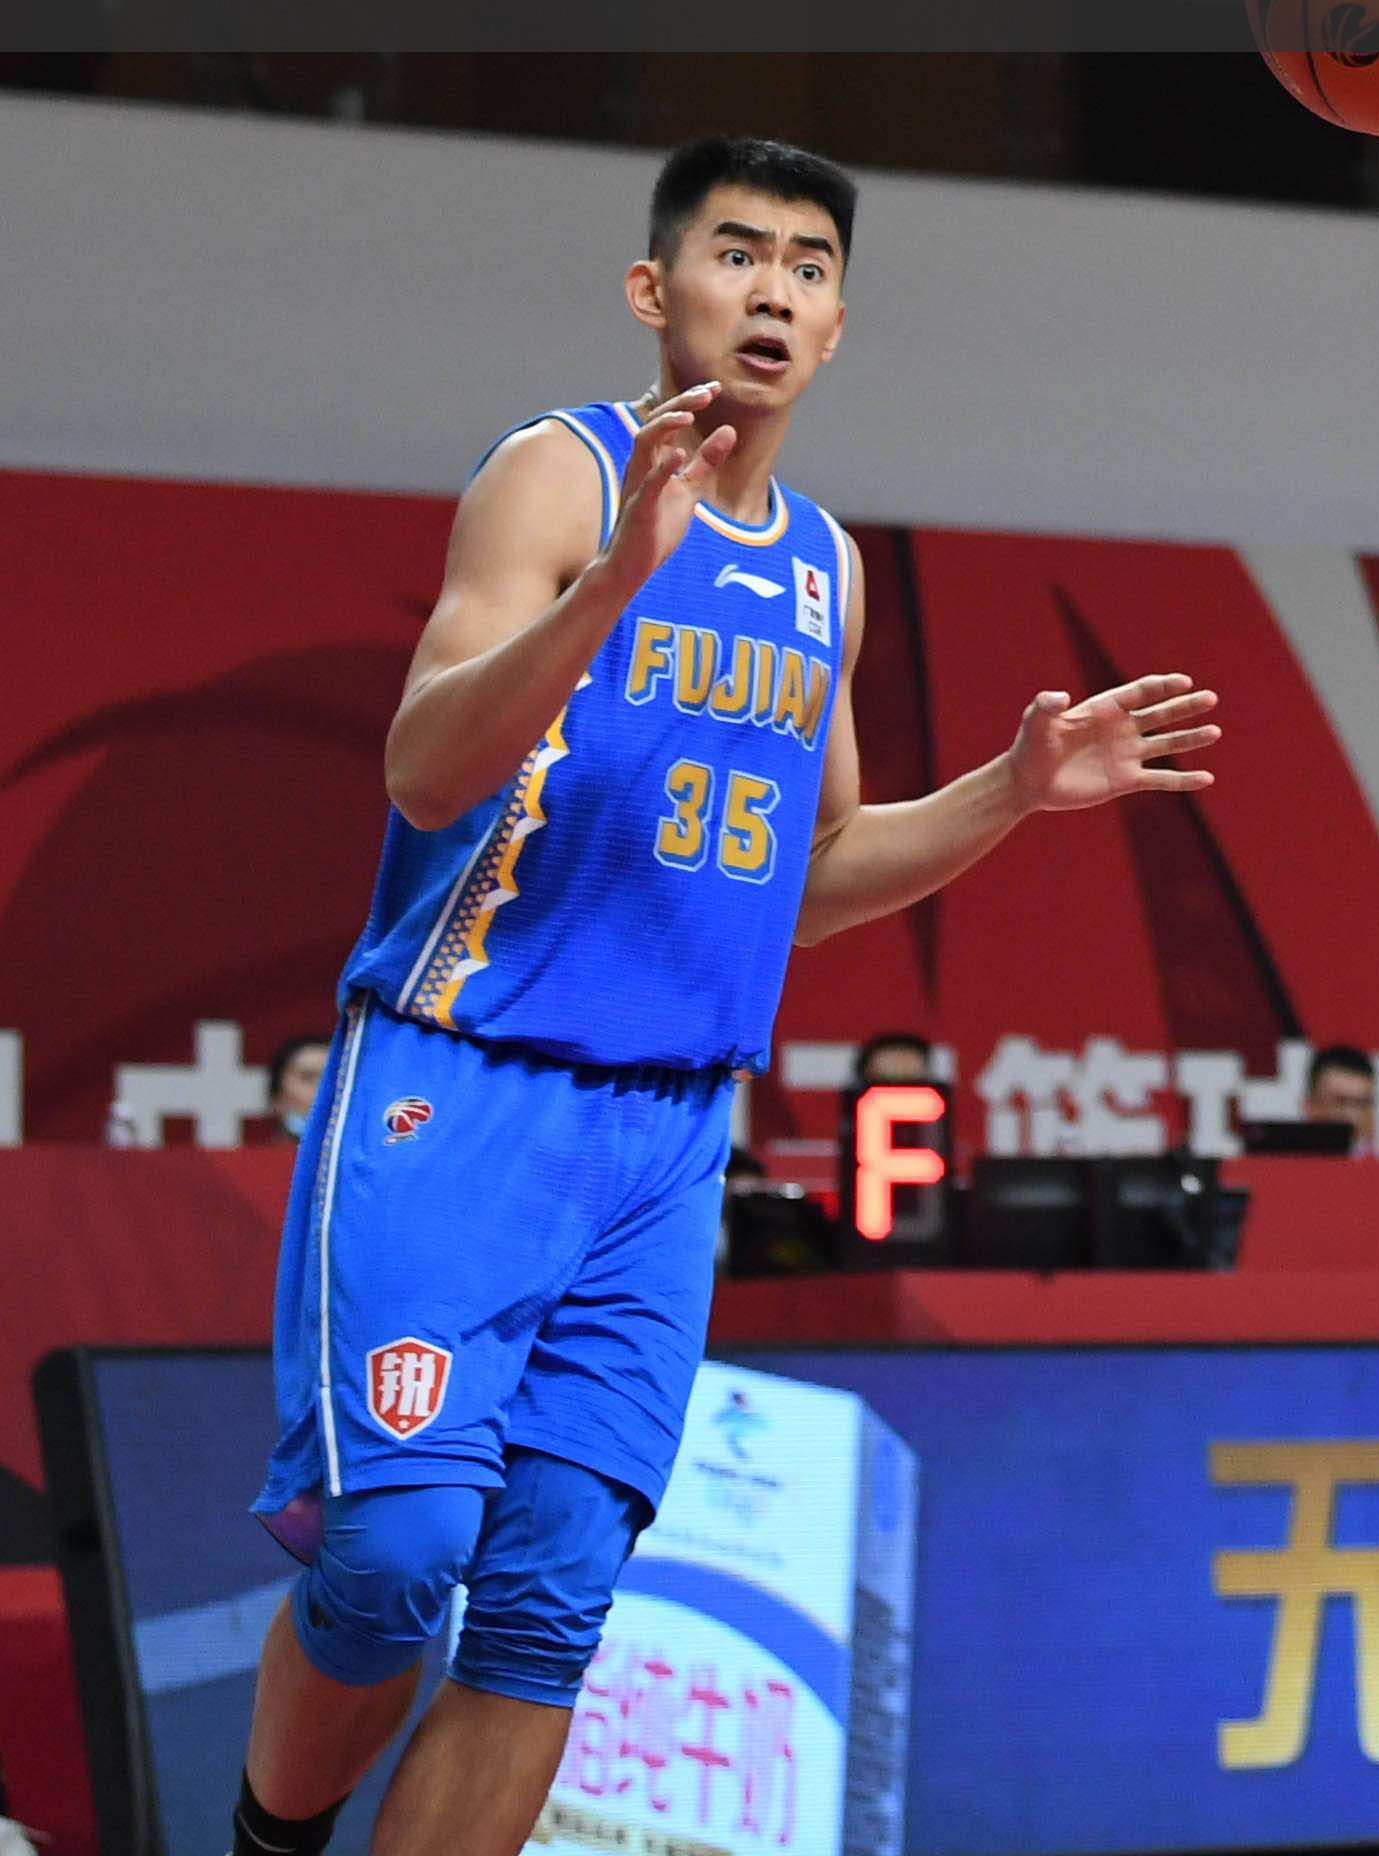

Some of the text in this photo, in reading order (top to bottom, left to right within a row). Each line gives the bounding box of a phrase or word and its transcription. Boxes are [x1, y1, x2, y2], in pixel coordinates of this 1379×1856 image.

[625, 618, 831, 751] FUJIAN
[654, 758, 781, 885] 35
[855, 1085, 946, 1240] F
